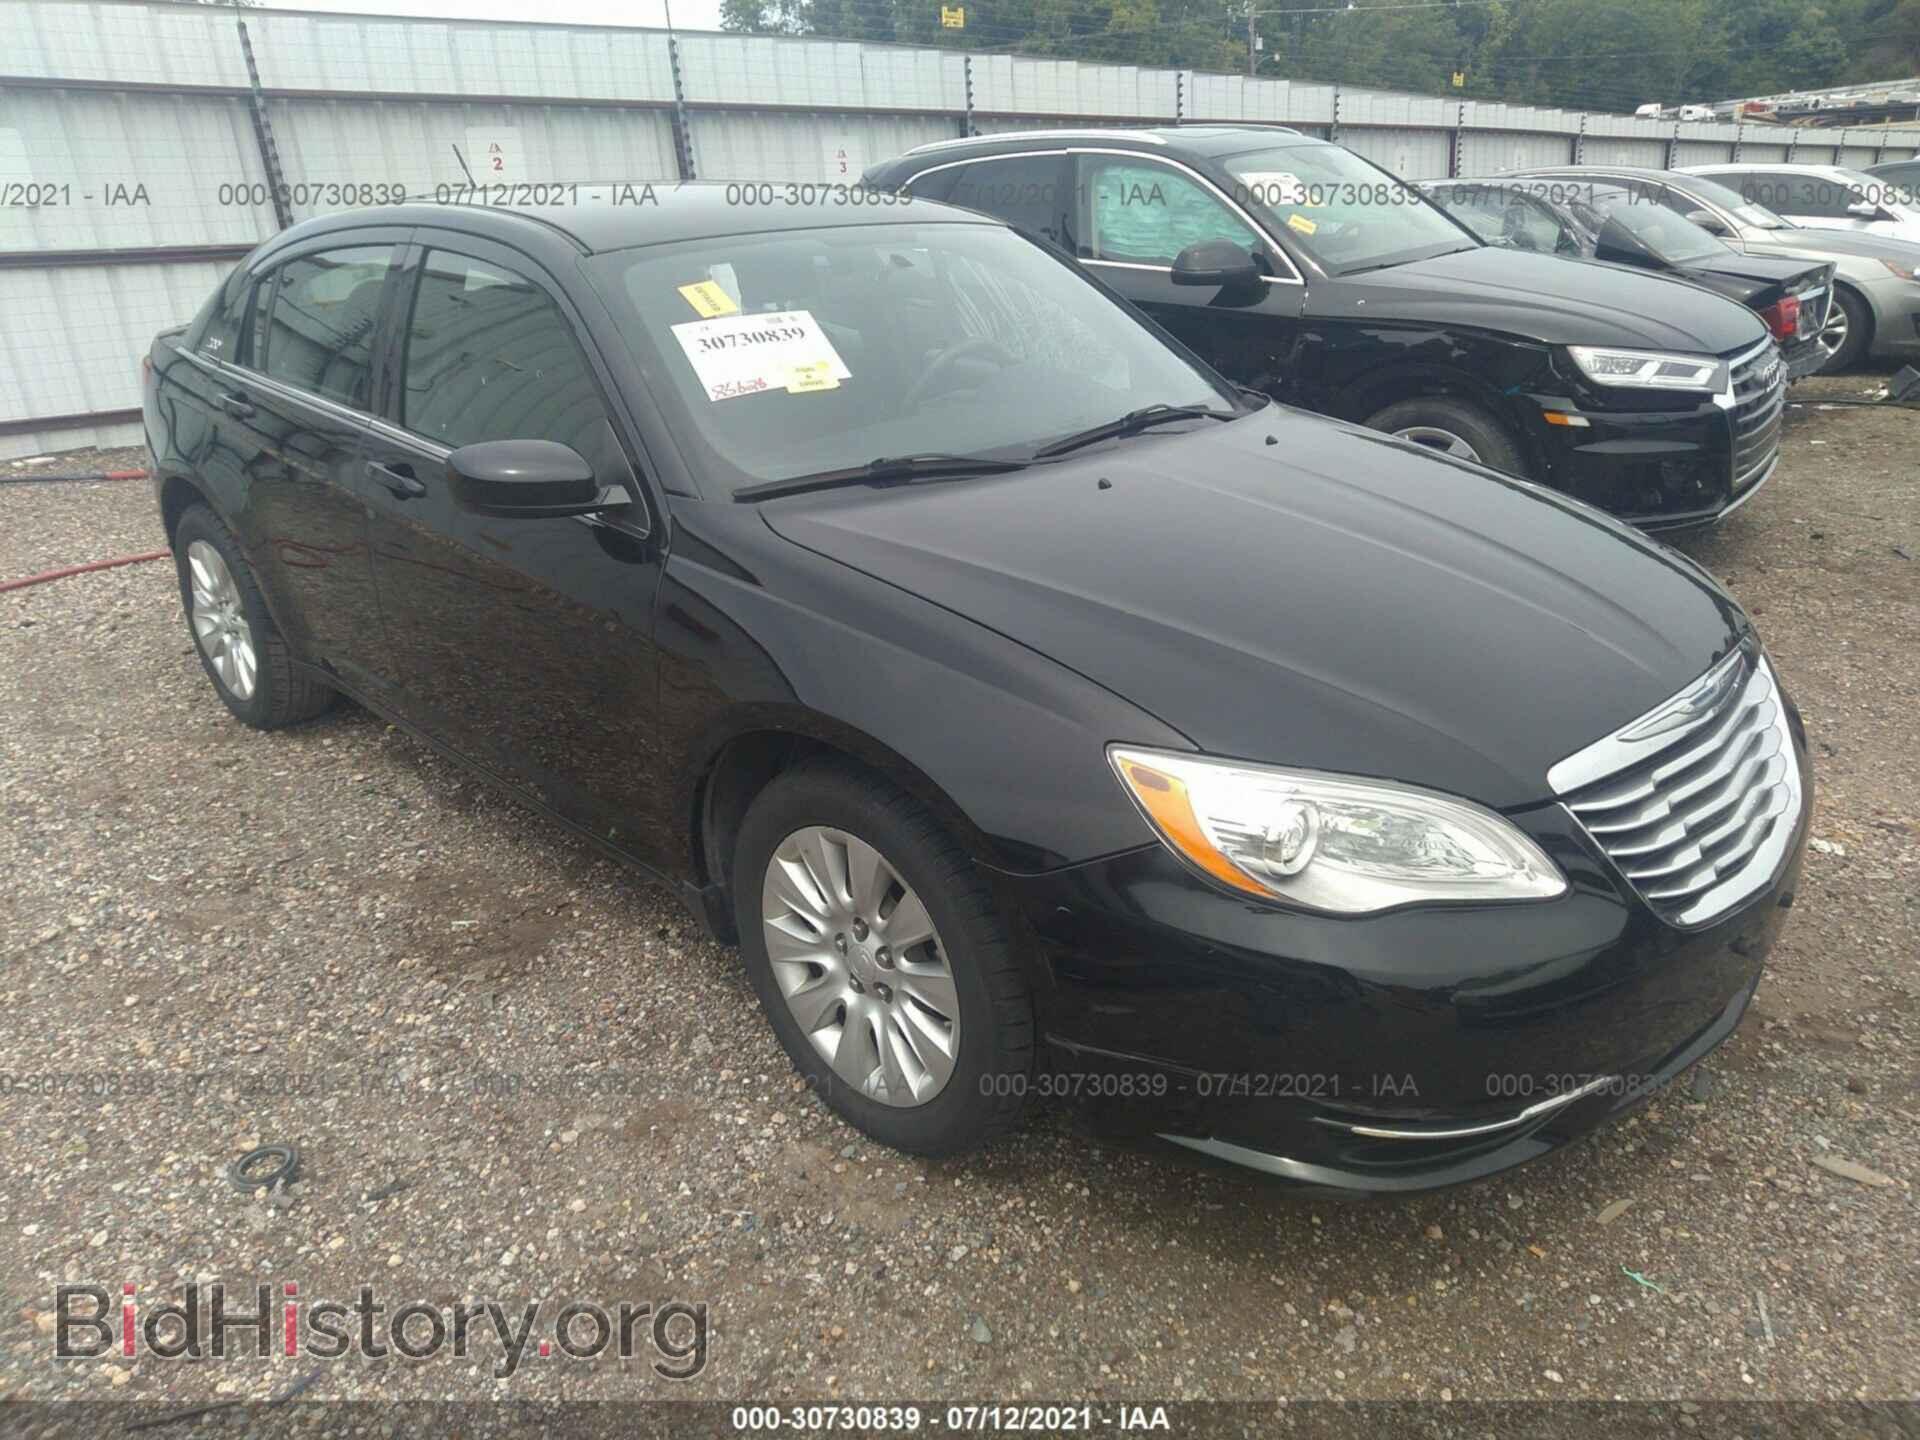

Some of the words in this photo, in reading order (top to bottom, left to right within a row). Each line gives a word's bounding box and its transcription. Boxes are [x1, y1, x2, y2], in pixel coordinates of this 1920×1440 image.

[492, 157, 504, 171] 2
[839, 161, 848, 174] 3
[697, 327, 806, 353] 30730839
